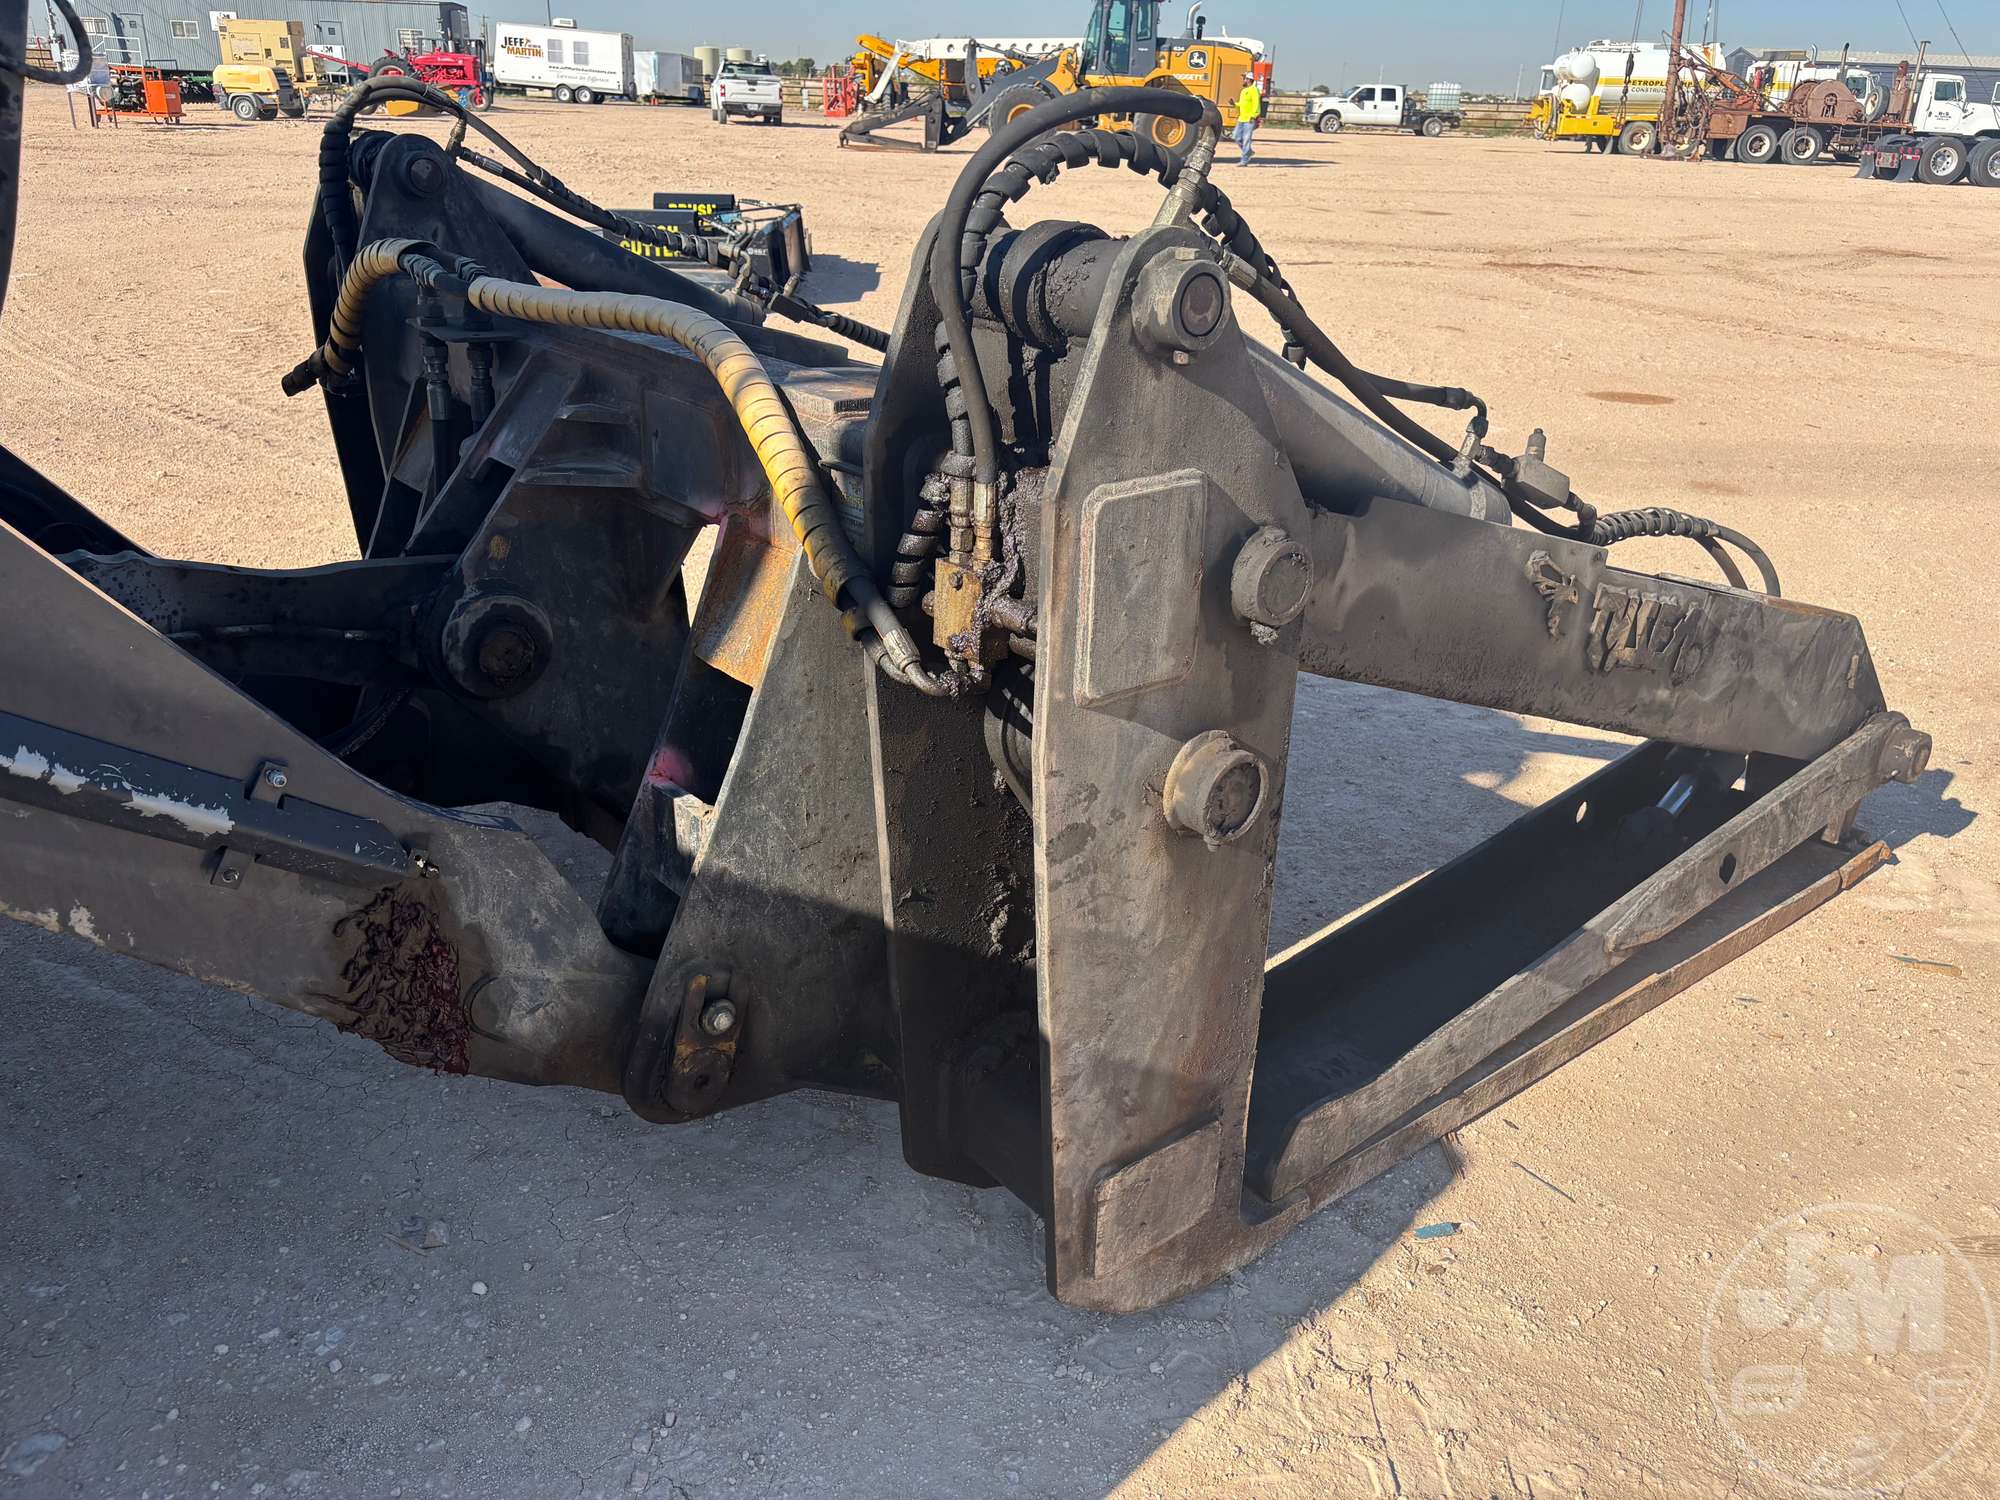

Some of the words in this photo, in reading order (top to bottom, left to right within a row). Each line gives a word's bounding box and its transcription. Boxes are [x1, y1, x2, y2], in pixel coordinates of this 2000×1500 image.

[501, 36, 524, 48] JEFF
[507, 46, 541, 58] MARTIN
[1629, 79, 1665, 87] ETROPL
[619, 240, 681, 257] CUTTE
